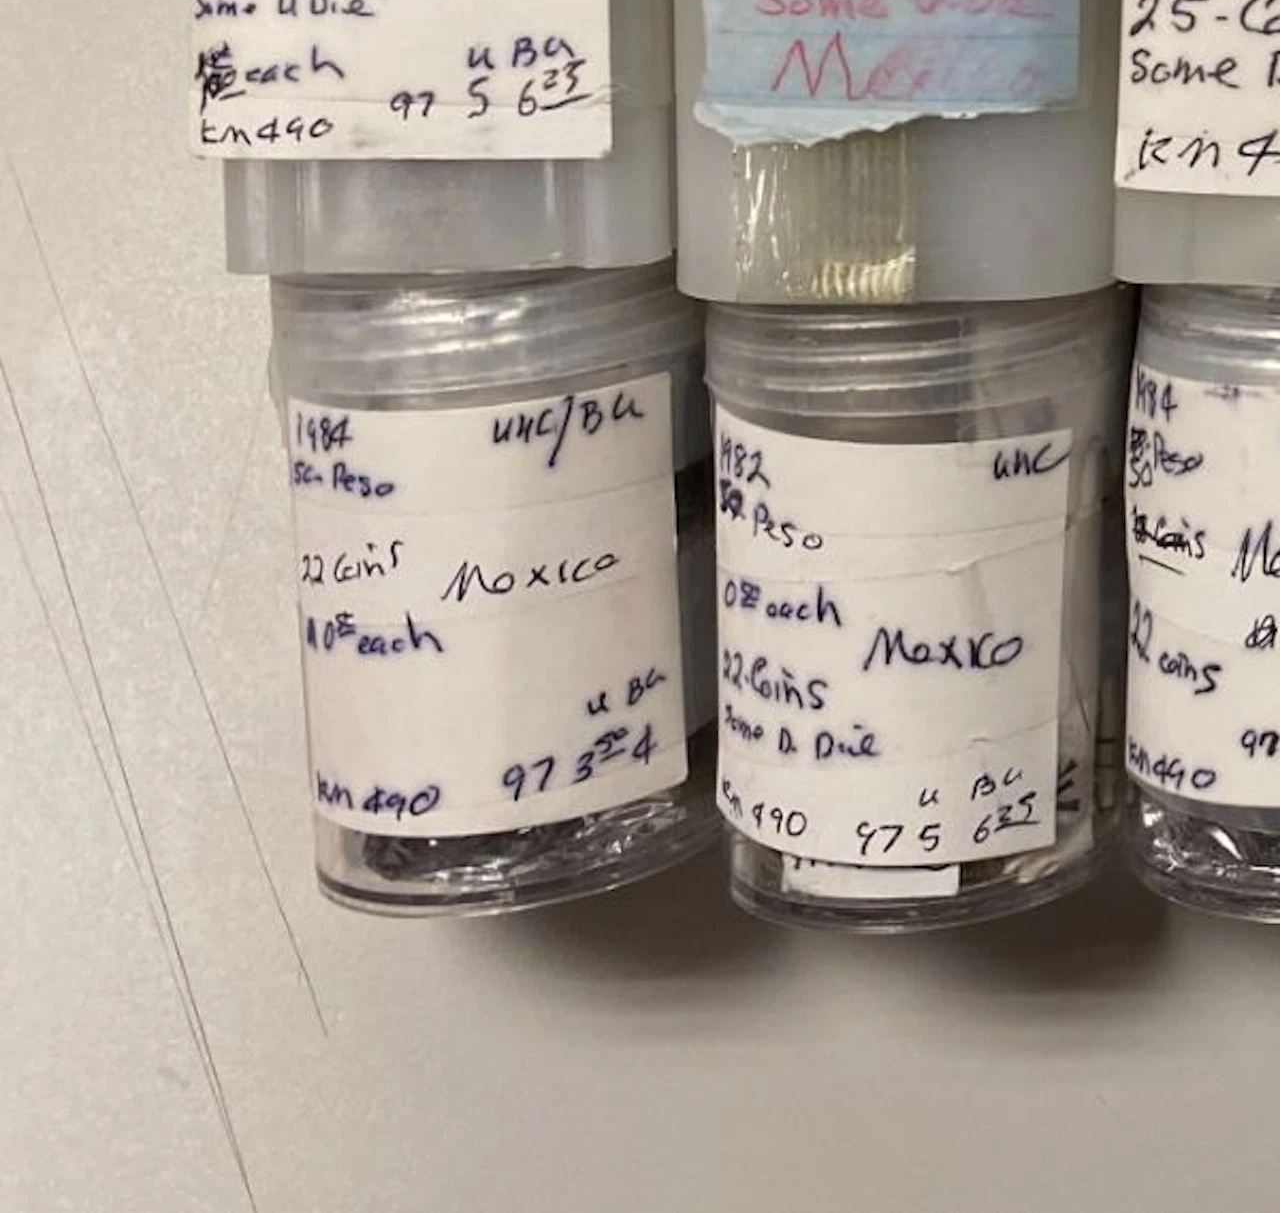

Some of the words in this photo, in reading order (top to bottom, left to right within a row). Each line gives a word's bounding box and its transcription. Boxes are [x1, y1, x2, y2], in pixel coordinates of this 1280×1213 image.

[246, 46, 344, 82] each
[1130, 49, 1241, 87] Some
[468, 77, 490, 118] 5
[298, 413, 352, 452] 1984
[752, 503, 824, 550] Peso
[441, 553, 621, 602] Mexico
[863, 628, 1023, 671] Mexico
[362, 786, 441, 821] 490
[502, 758, 555, 801] 97
[634, 725, 656, 765] 4
[919, 825, 941, 852] 5
